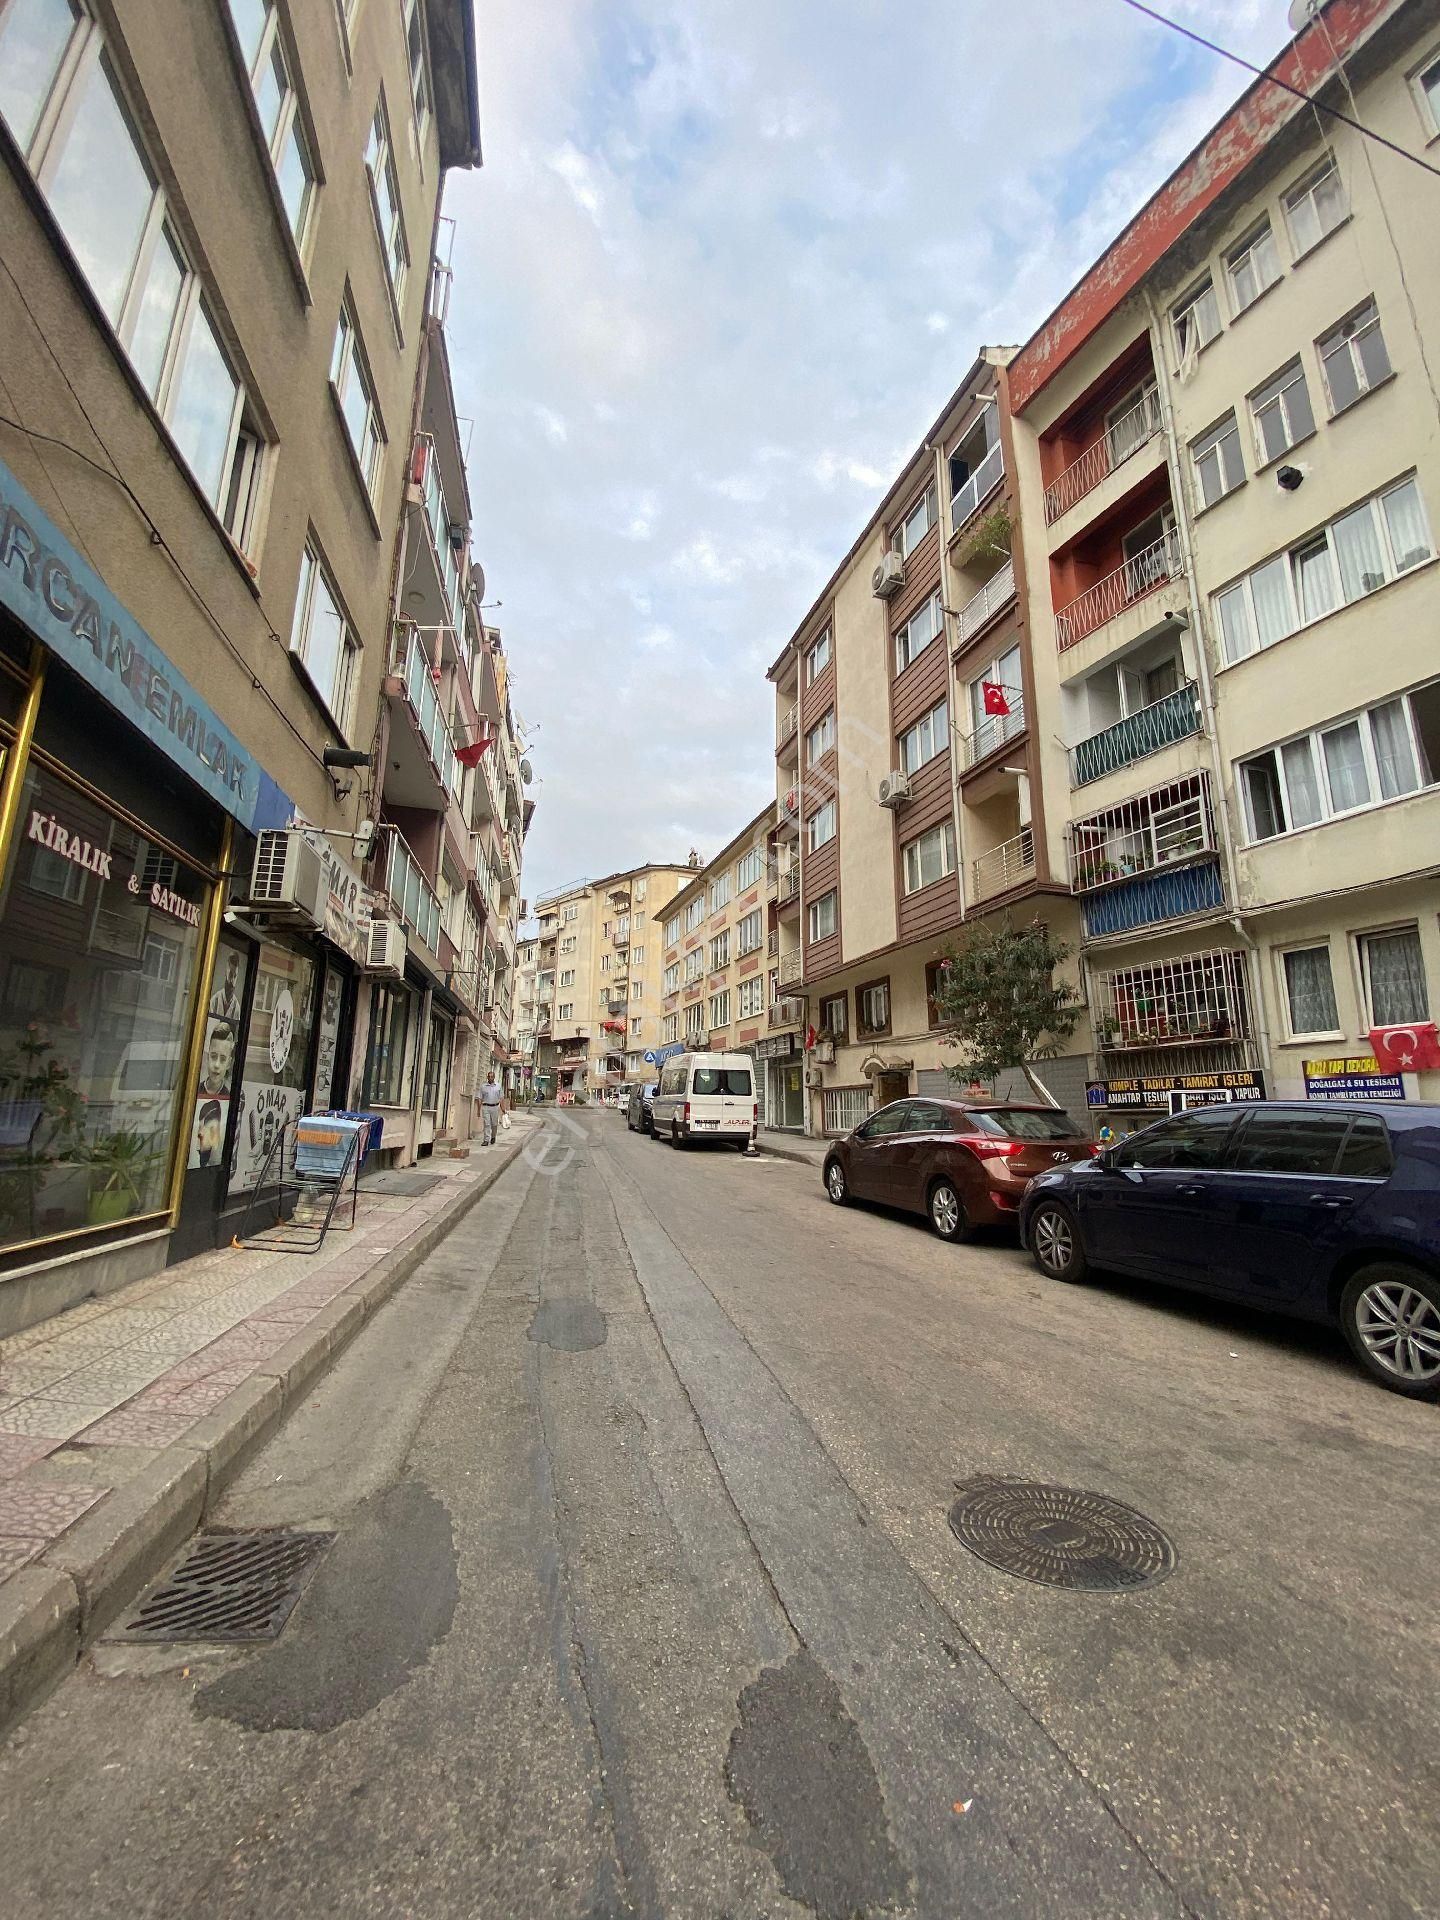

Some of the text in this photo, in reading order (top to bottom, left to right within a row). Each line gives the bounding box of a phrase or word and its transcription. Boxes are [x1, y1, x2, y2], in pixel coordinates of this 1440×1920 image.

[0, 503, 248, 801] RCAN EMLAK
[28, 811, 201, 927] KİRALIK & SATILIK
[1346, 1058, 1380, 1072] DEKORA
[1109, 1080, 1138, 1091] KOMPLE
[1354, 1079, 1364, 1087] SU
[257, 1089, 287, 1114] ÖMAR
[1108, 1092, 1141, 1103] ANAHTAR
[1143, 1090, 1170, 1102] TESLİM
[1235, 1086, 1262, 1099] YAPILIR
